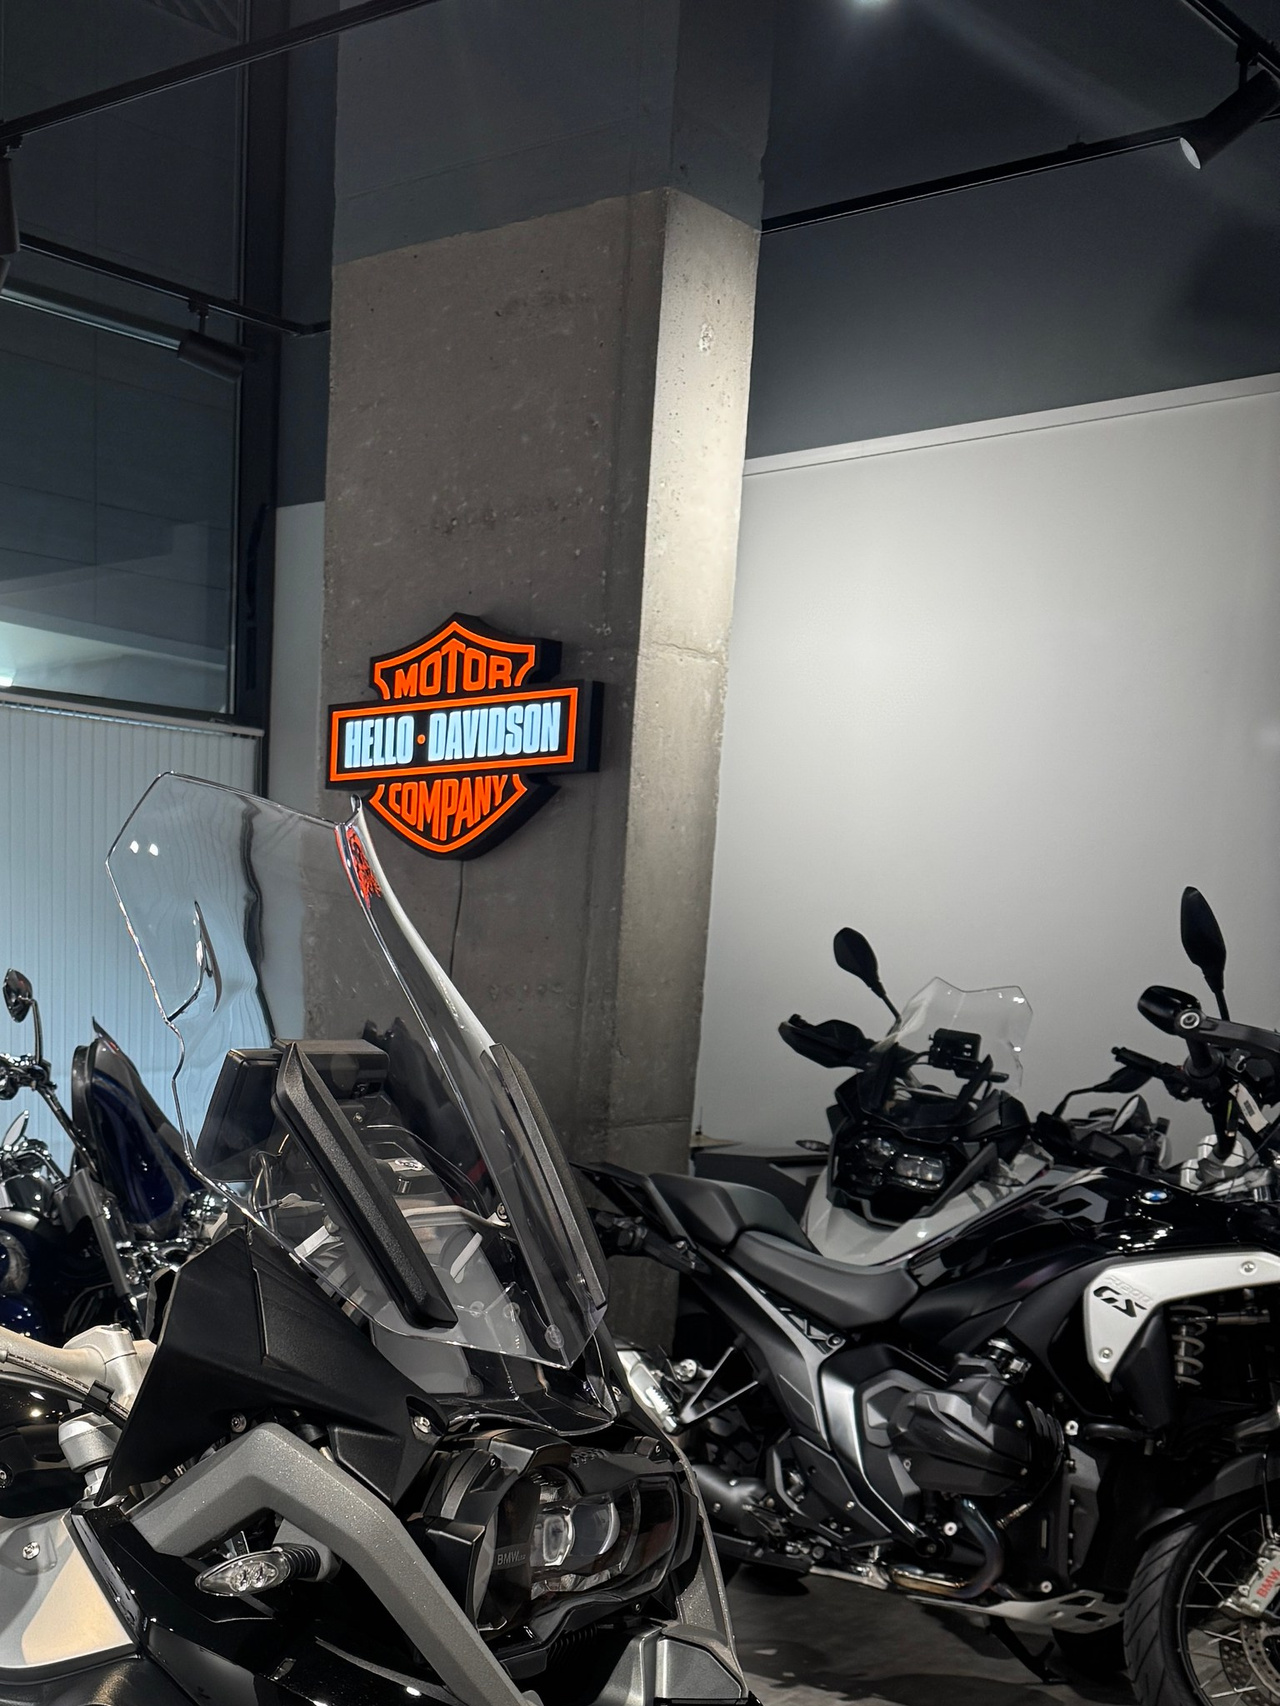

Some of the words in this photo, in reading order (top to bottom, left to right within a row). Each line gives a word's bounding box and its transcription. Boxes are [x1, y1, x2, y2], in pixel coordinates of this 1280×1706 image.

[393, 637, 514, 699] MOTOR
[344, 715, 414, 769] HELLO
[427, 701, 561, 762] DAVIDSON
[388, 774, 508, 841] COMPANY
[1093, 1285, 1148, 1318] GS
[1255, 1567, 1280, 1599] BMW
